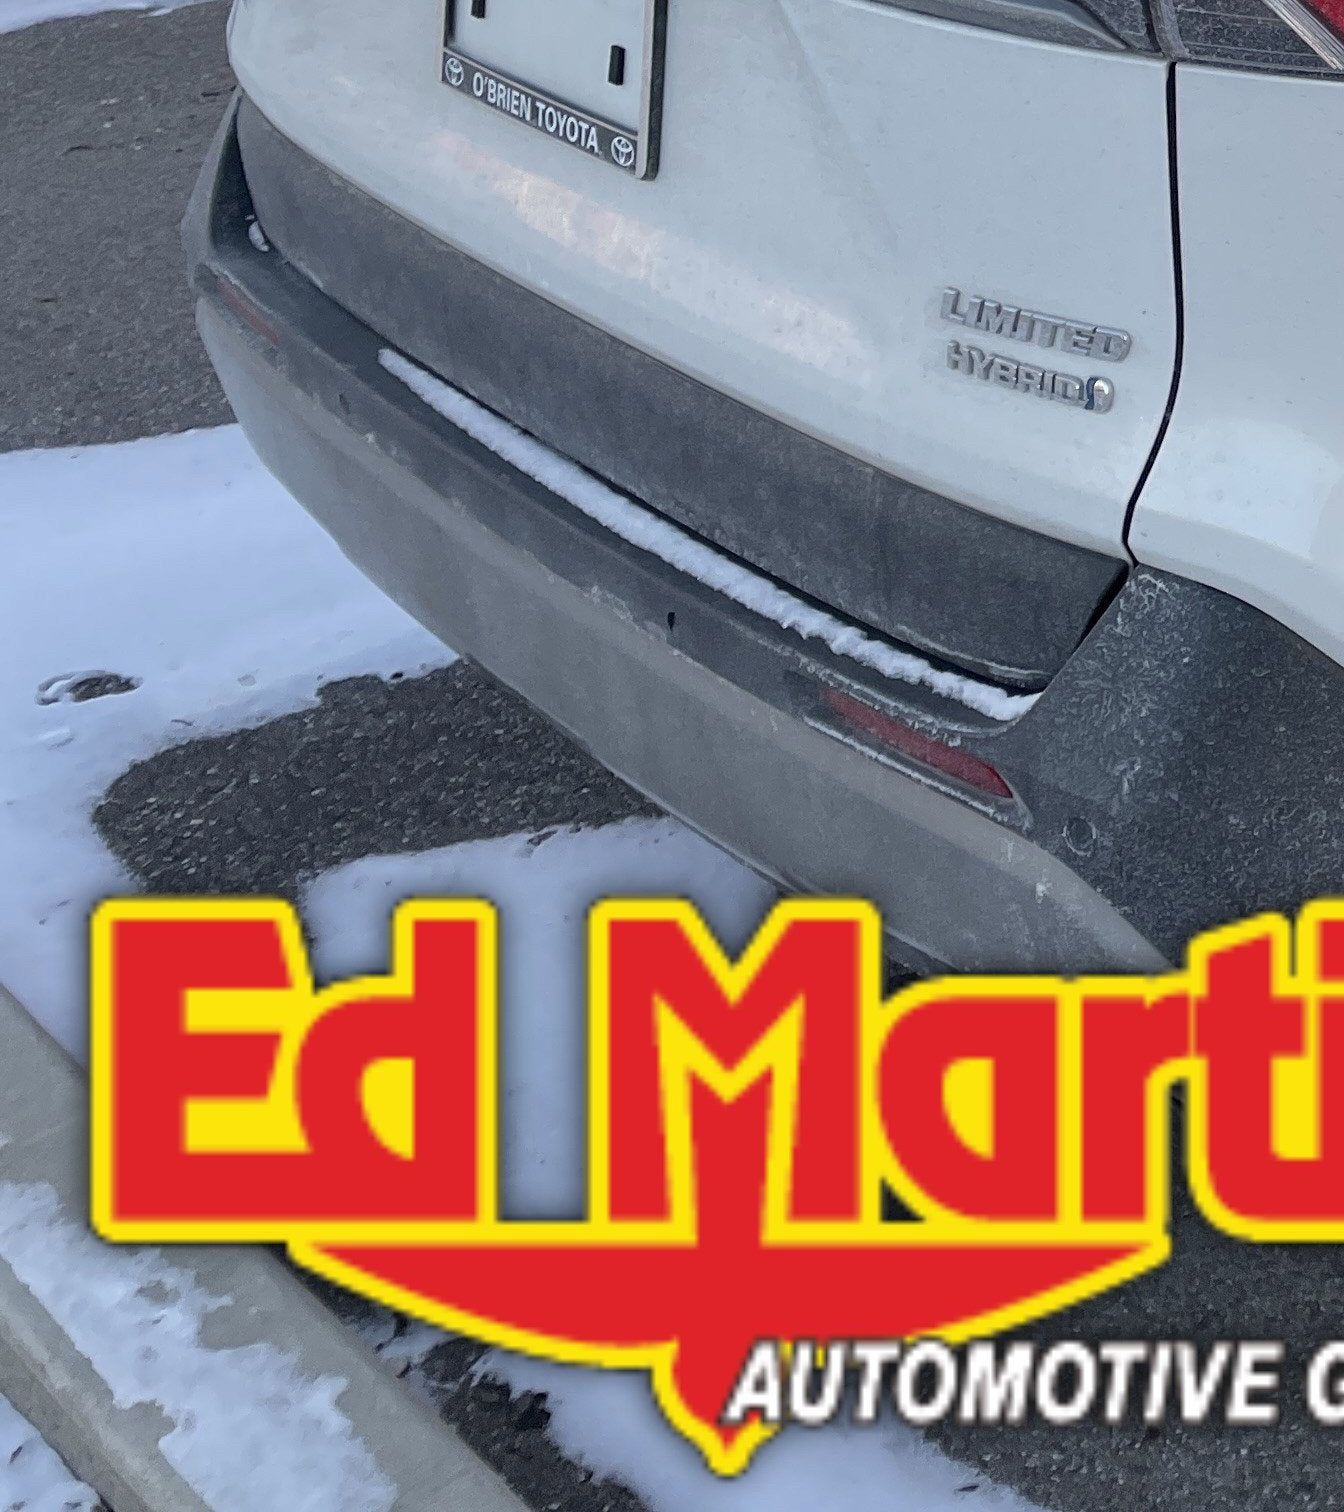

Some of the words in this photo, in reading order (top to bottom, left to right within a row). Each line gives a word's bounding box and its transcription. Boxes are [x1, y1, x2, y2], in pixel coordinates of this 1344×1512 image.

[472, 71, 532, 122] O'BRIEN
[536, 103, 601, 155] TOYOTA
[940, 286, 1132, 363] LIMITED
[946, 339, 1087, 409] HYBRID
